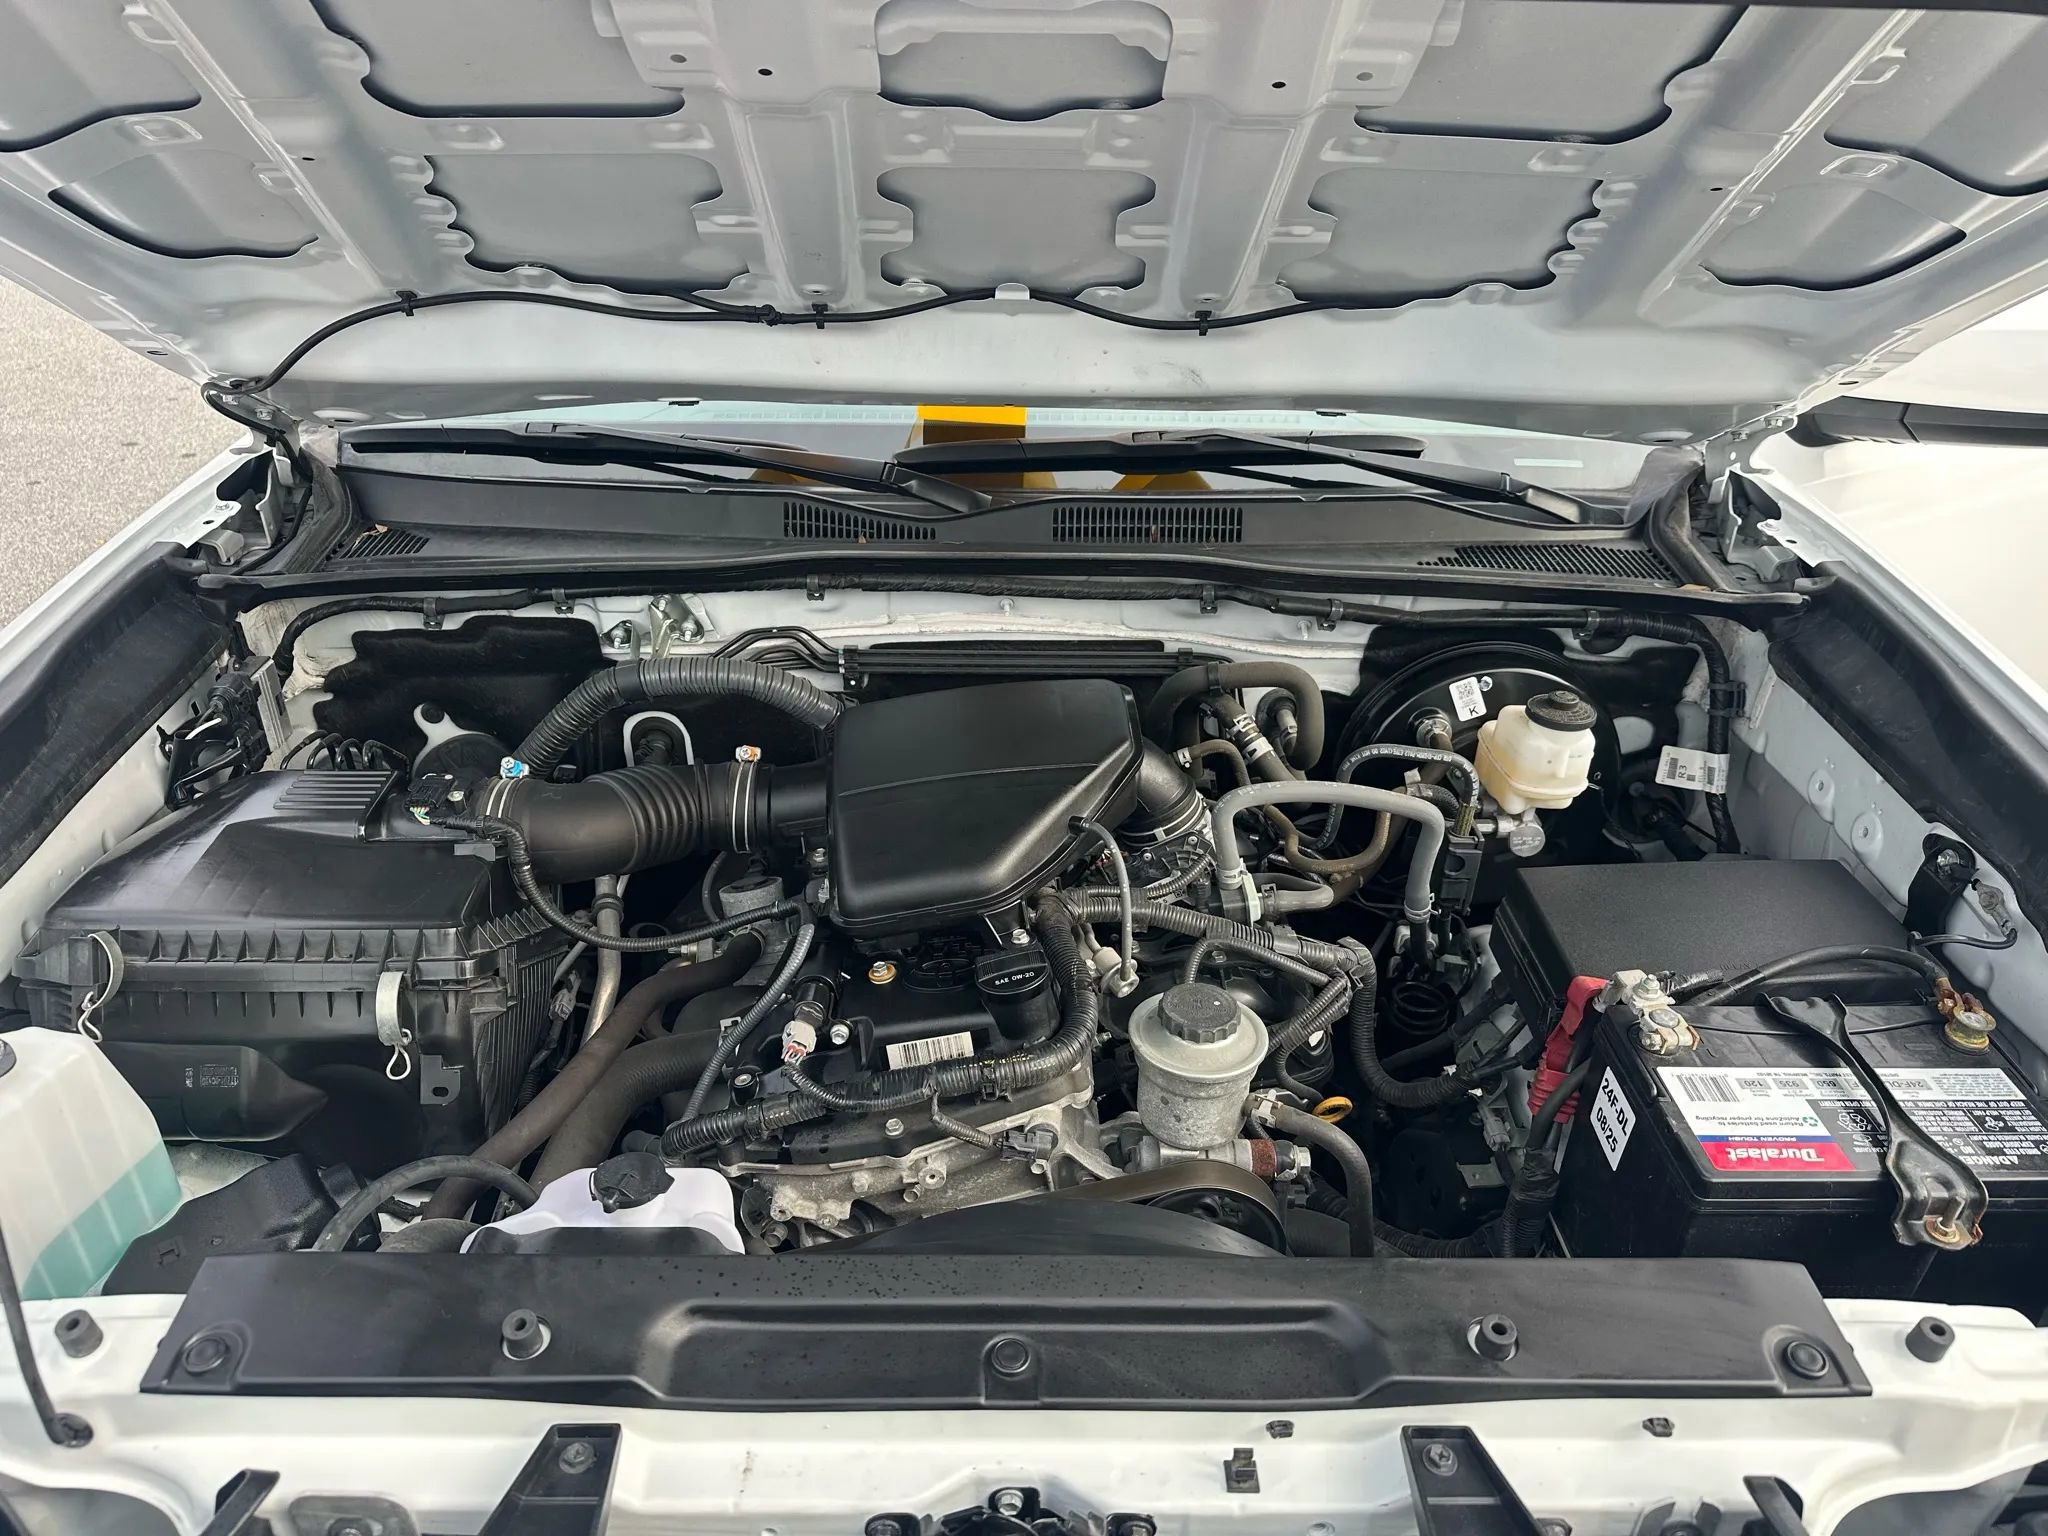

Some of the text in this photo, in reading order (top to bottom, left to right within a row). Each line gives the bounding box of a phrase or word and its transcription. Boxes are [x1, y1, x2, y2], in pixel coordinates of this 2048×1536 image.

[1468, 705, 1479, 716] K
[1678, 764, 1688, 779] R3
[994, 971, 1035, 986] SAE 0W-20
[1816, 1080, 1837, 1088] 650
[1601, 1077, 1629, 1136] 24F-DL
[1596, 1106, 1618, 1153] 08/25
[1725, 1148, 1825, 1162] Duralast
